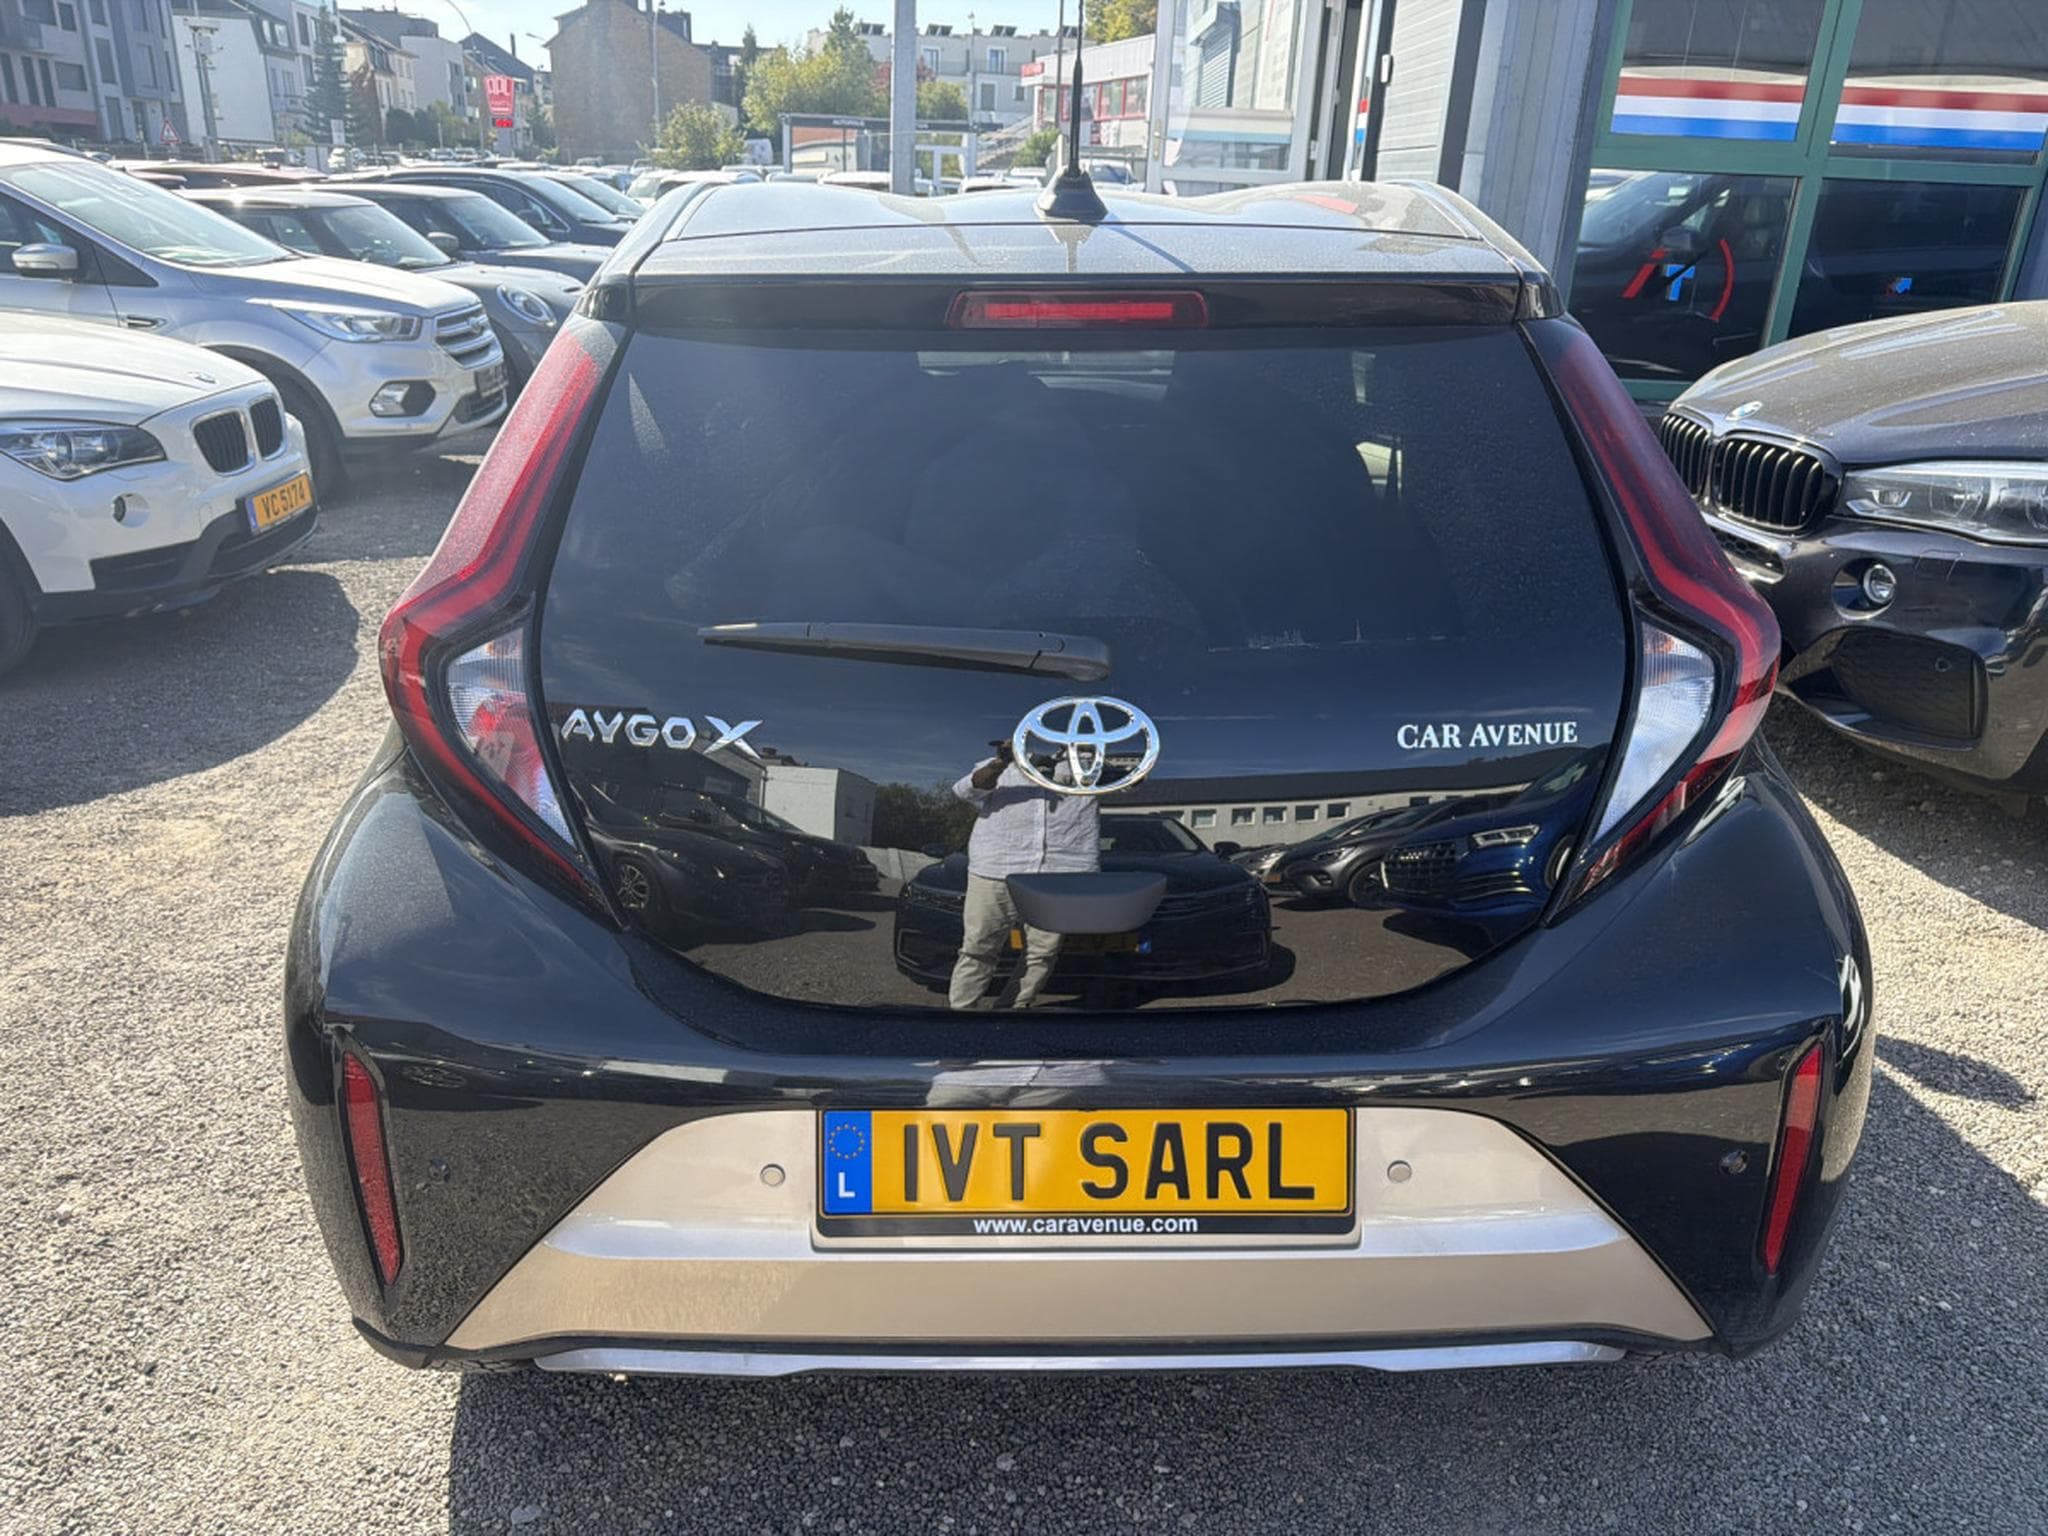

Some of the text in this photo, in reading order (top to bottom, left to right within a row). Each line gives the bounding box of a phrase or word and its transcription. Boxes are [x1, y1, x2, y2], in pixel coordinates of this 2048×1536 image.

[261, 480, 305, 519] VC 5174
[561, 708, 764, 760] AYGO X
[1397, 721, 1578, 749] CAR AVENUE
[903, 1121, 1316, 1202] IVT SARL
[838, 1171, 856, 1199] L
[973, 1216, 1199, 1234] www.caravenue.com
